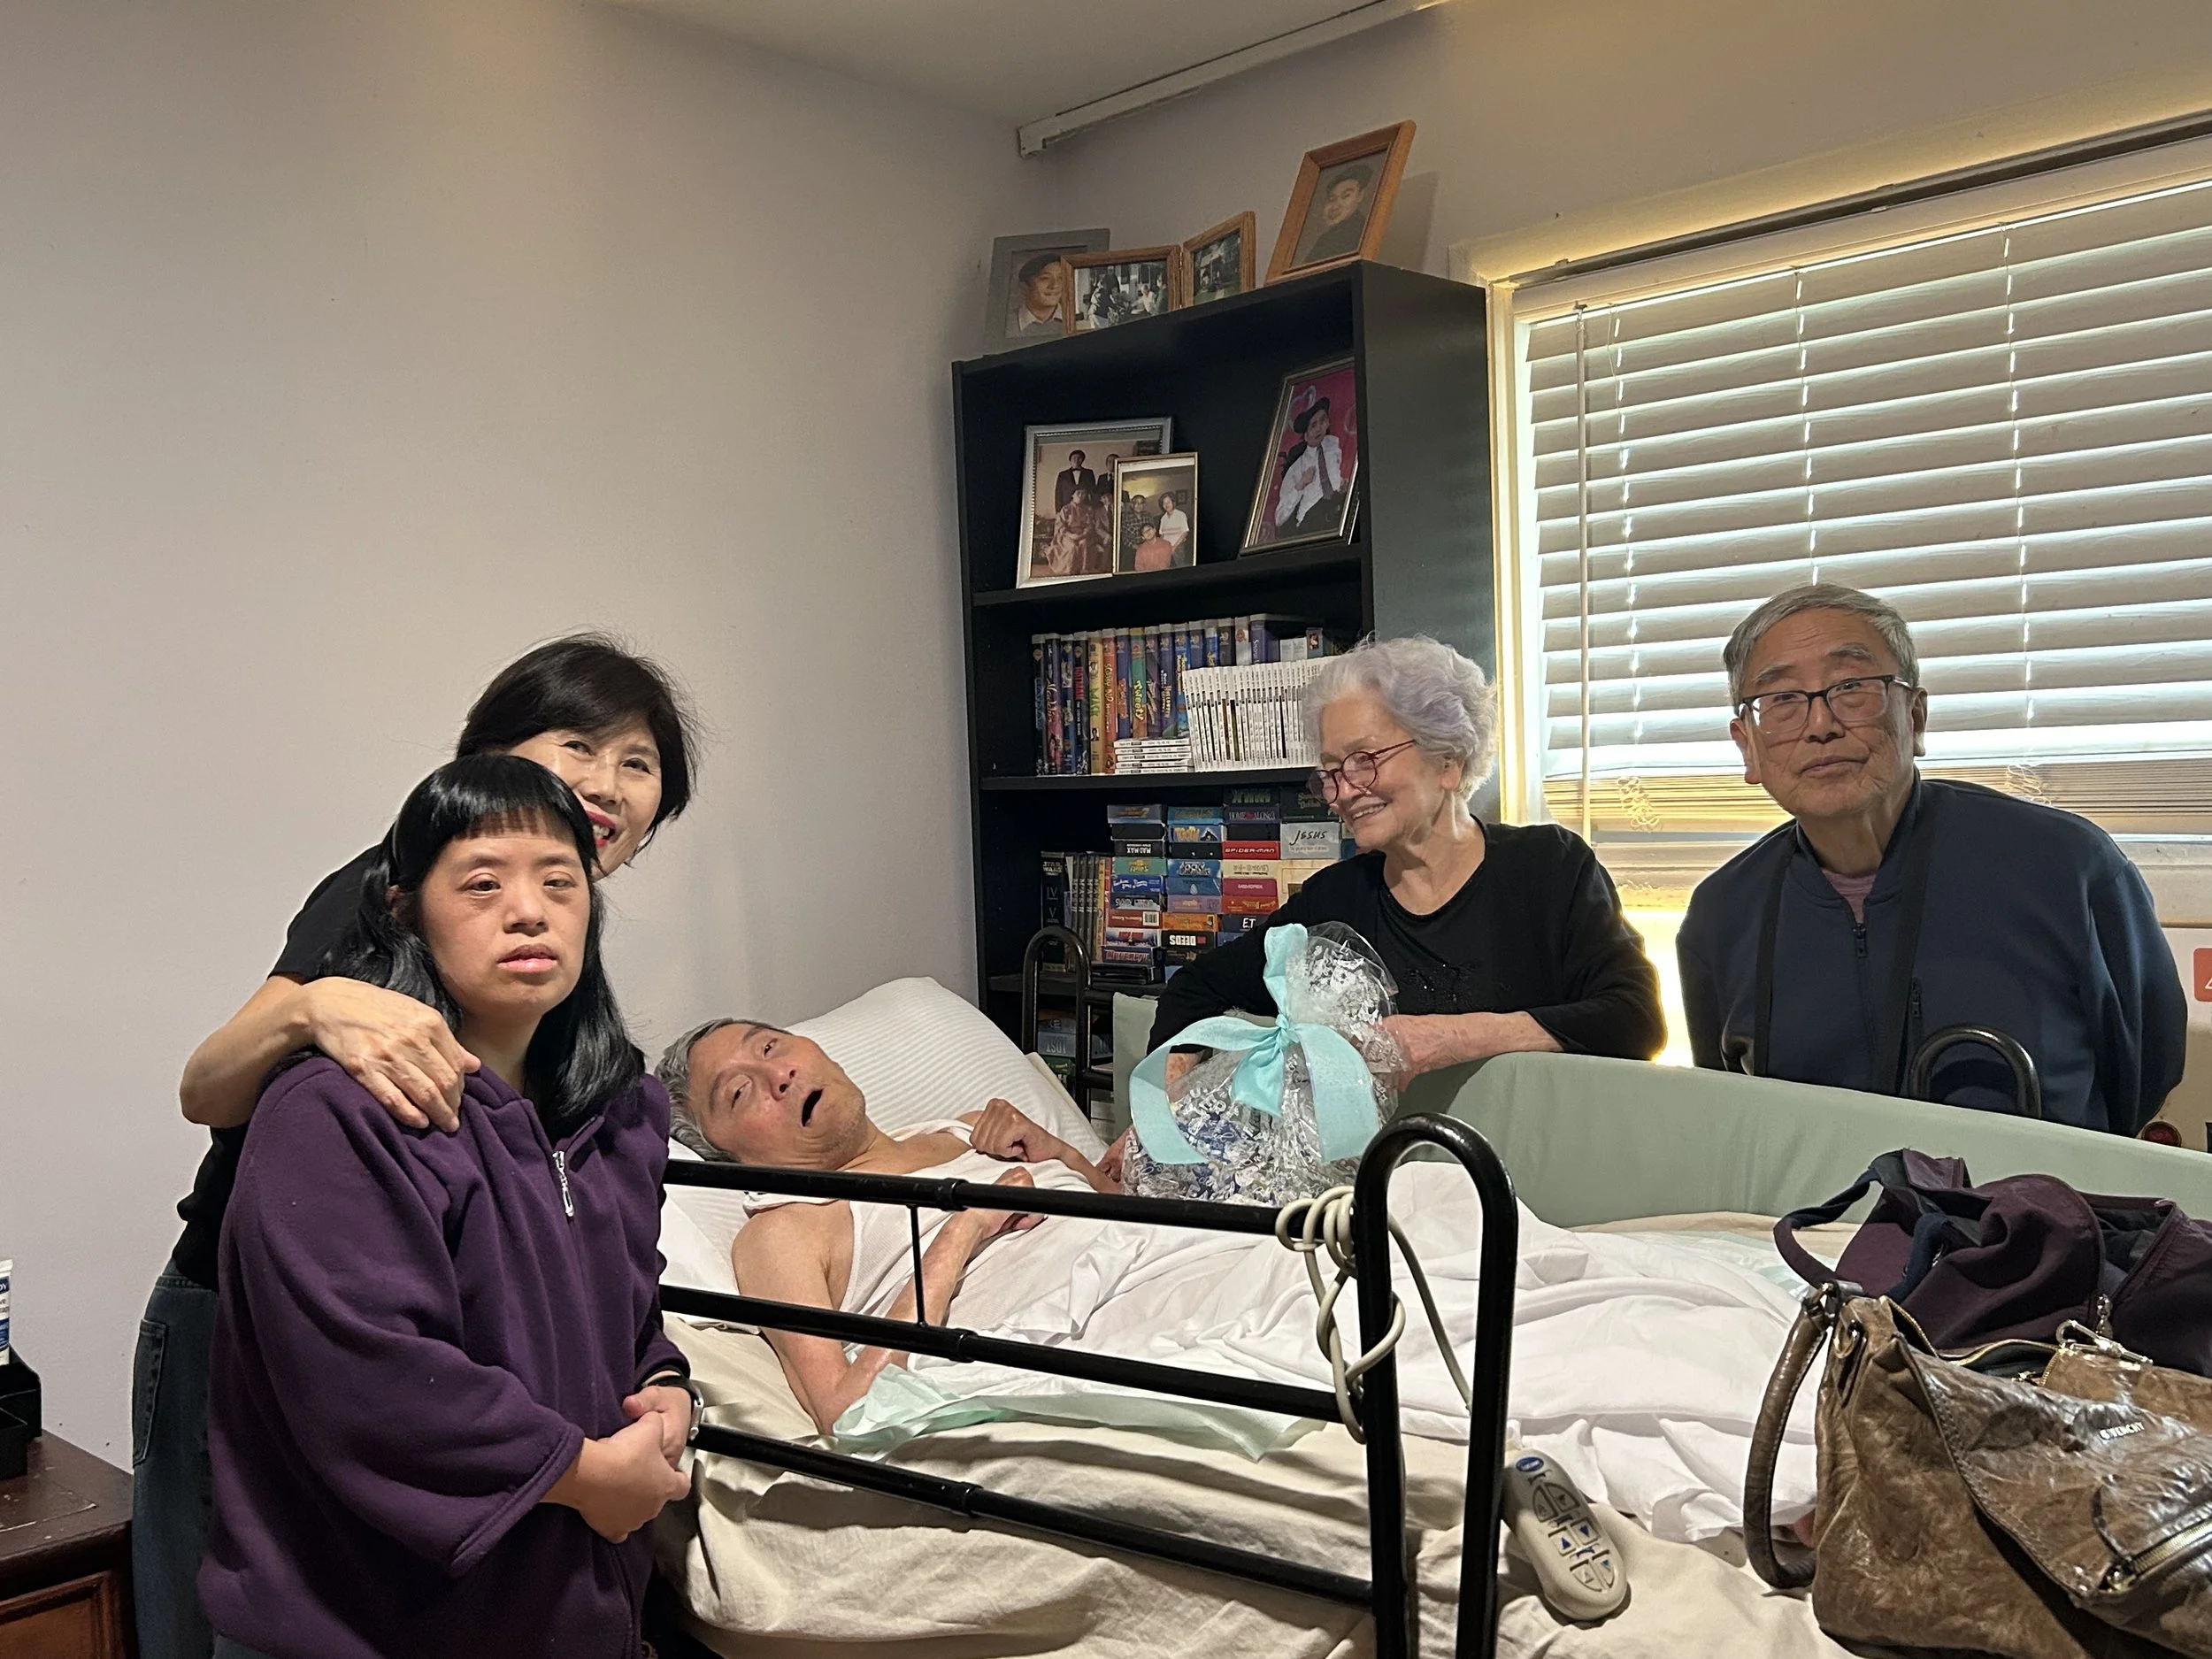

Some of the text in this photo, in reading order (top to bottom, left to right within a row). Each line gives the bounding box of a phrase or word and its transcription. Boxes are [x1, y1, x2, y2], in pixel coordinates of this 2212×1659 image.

[1075, 666, 1084, 701] BATMAN
[1090, 687, 1101, 717] MASK
[1134, 680, 1144, 721] Tweety
[1288, 830, 1327, 846] JESUS
[1169, 934, 1196, 946] DEEDS
[1046, 1040, 1066, 1054] LOST
